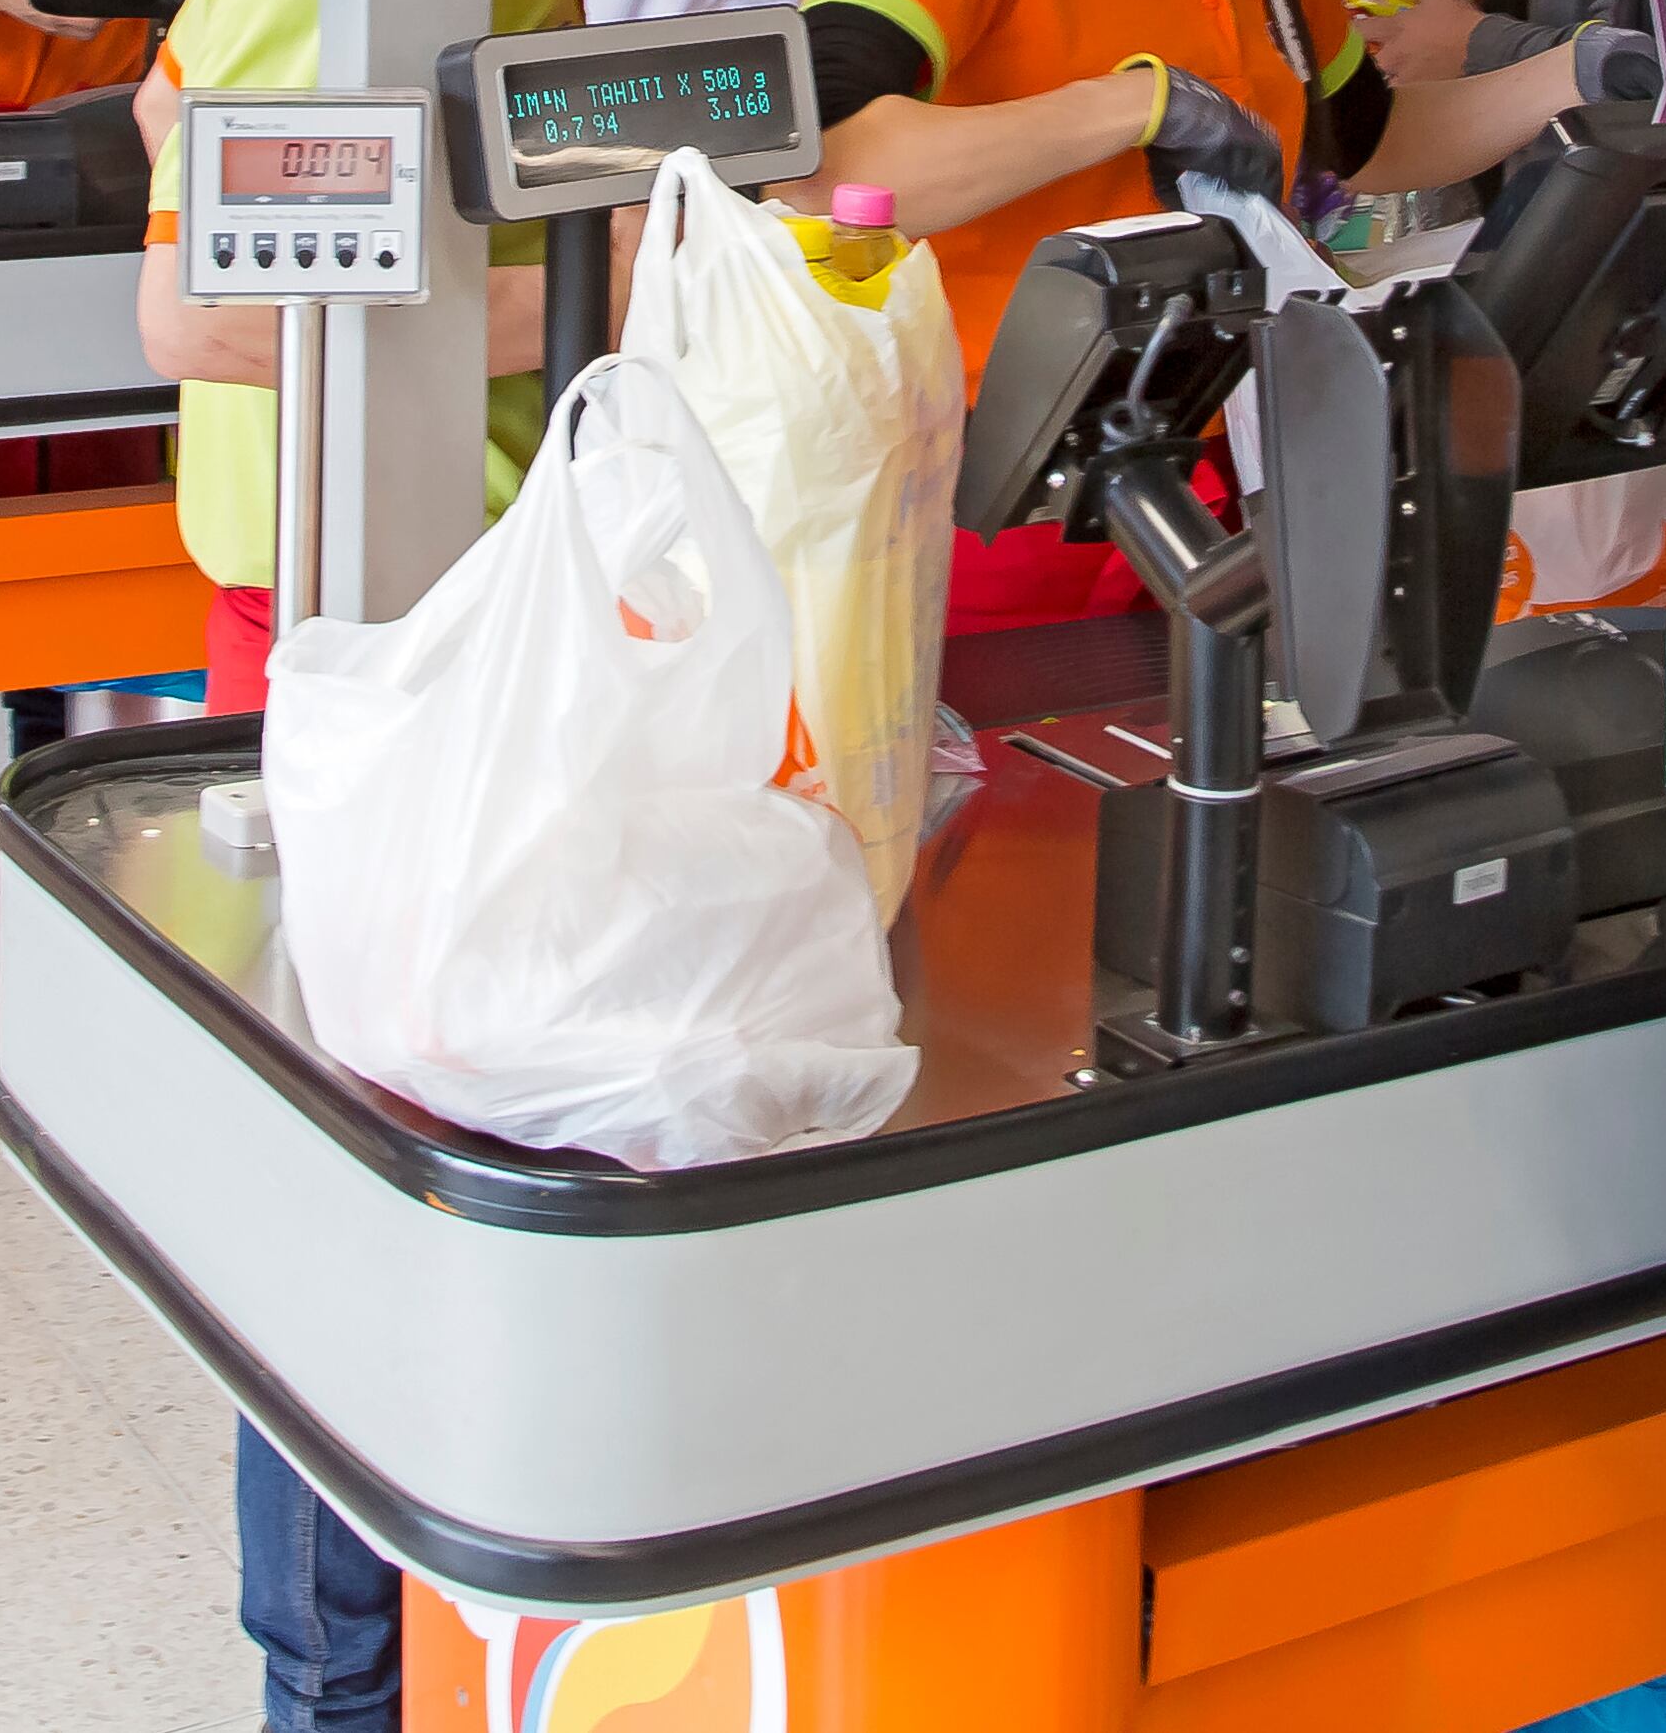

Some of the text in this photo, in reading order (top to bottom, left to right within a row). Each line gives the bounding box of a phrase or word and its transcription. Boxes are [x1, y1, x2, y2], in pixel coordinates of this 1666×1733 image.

[586, 76, 665, 109] TAHITI
[676, 72, 693, 96] X
[702, 67, 741, 93] 500
[754, 70, 766, 90] g
[707, 91, 771, 121] 3.160
